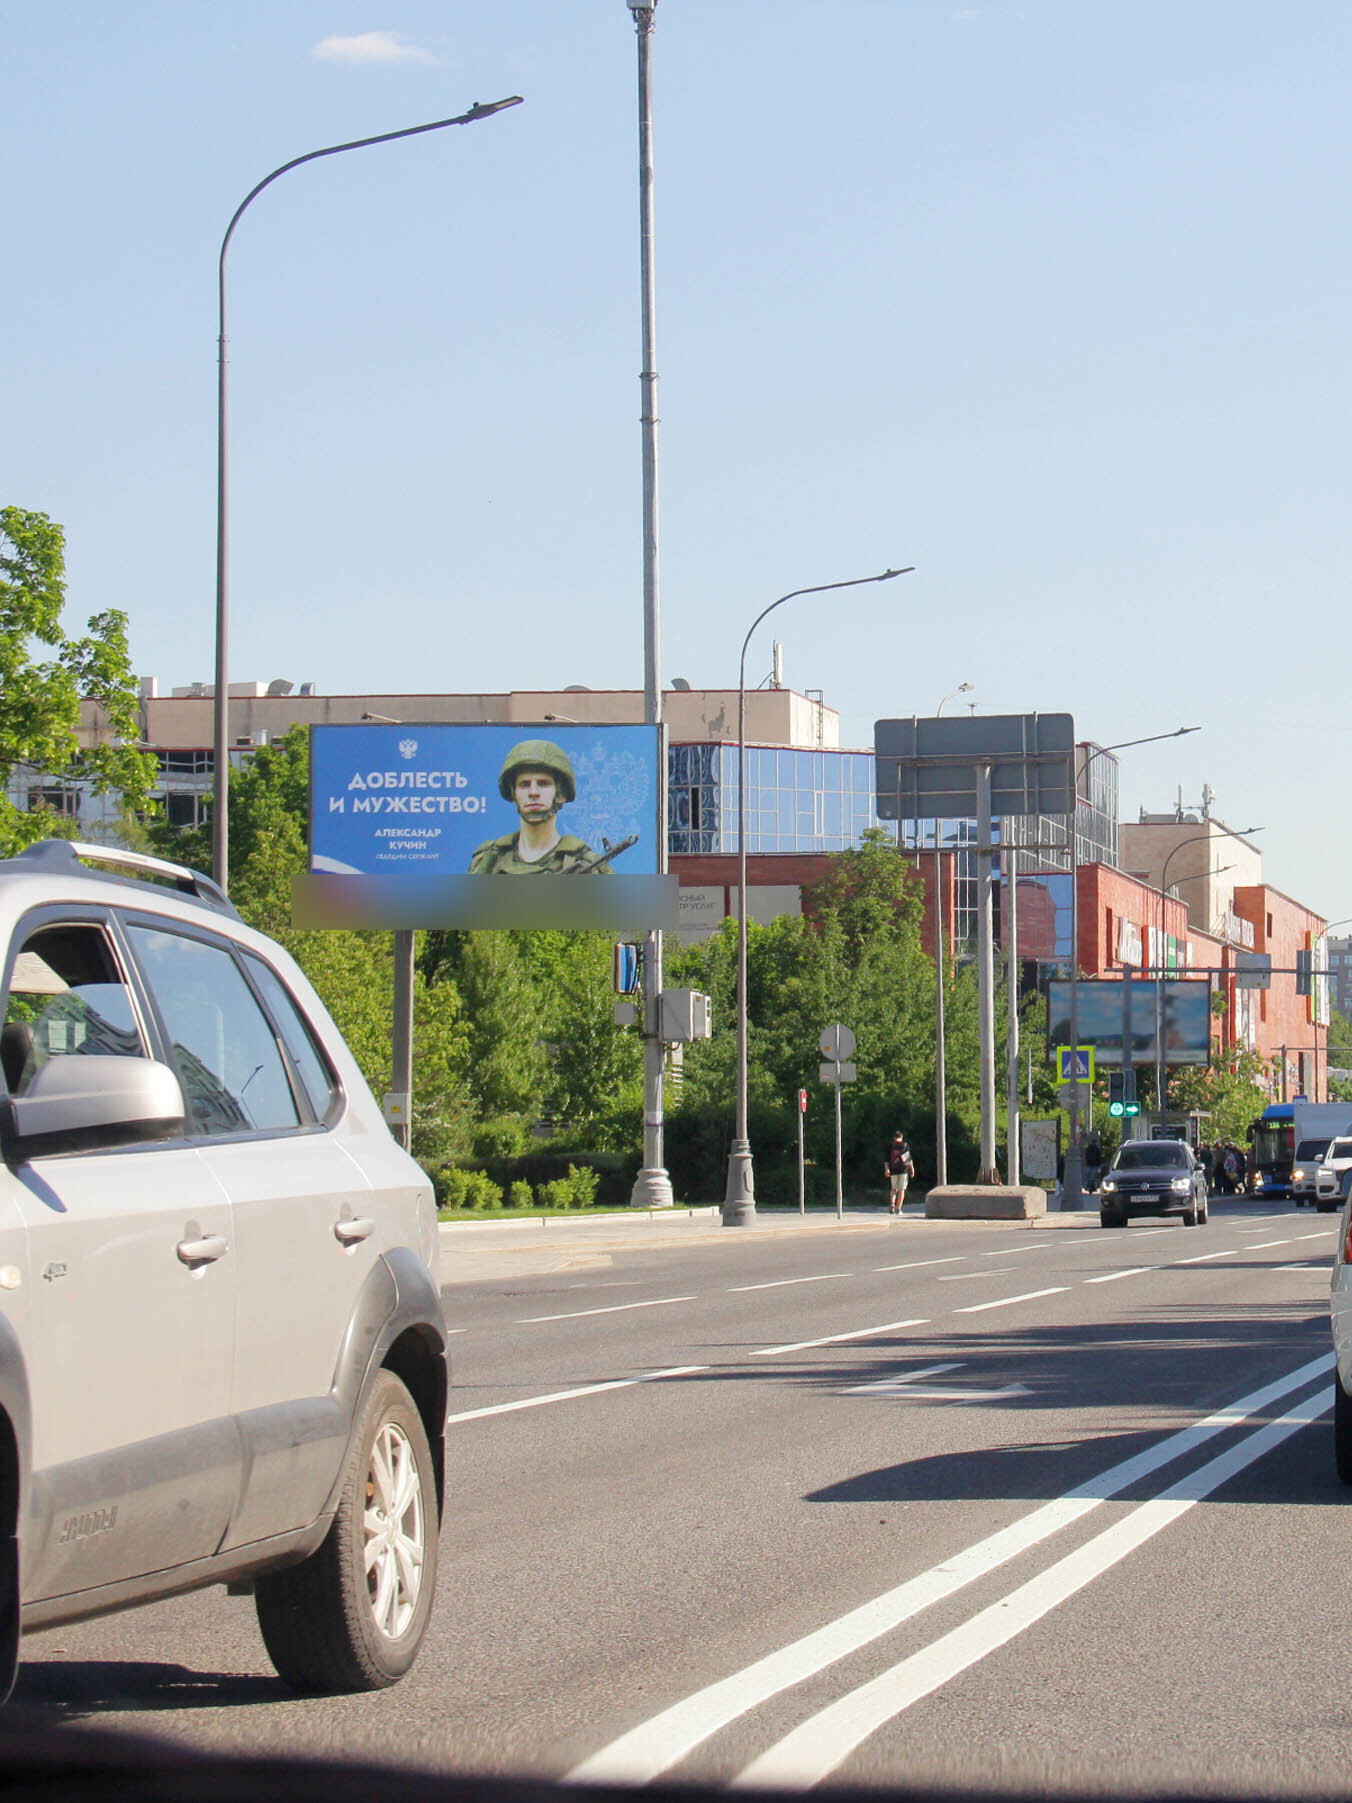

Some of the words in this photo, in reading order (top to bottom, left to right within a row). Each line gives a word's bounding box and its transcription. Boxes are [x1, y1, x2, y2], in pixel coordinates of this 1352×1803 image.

[348, 772, 468, 790] ДОБЛЕСТЬ
[329, 797, 345, 813] И
[352, 796, 487, 813] МУЖЕСТВО!
[374, 828, 441, 838] АЛЕКСАНДР
[389, 841, 427, 850] КУЧИН
